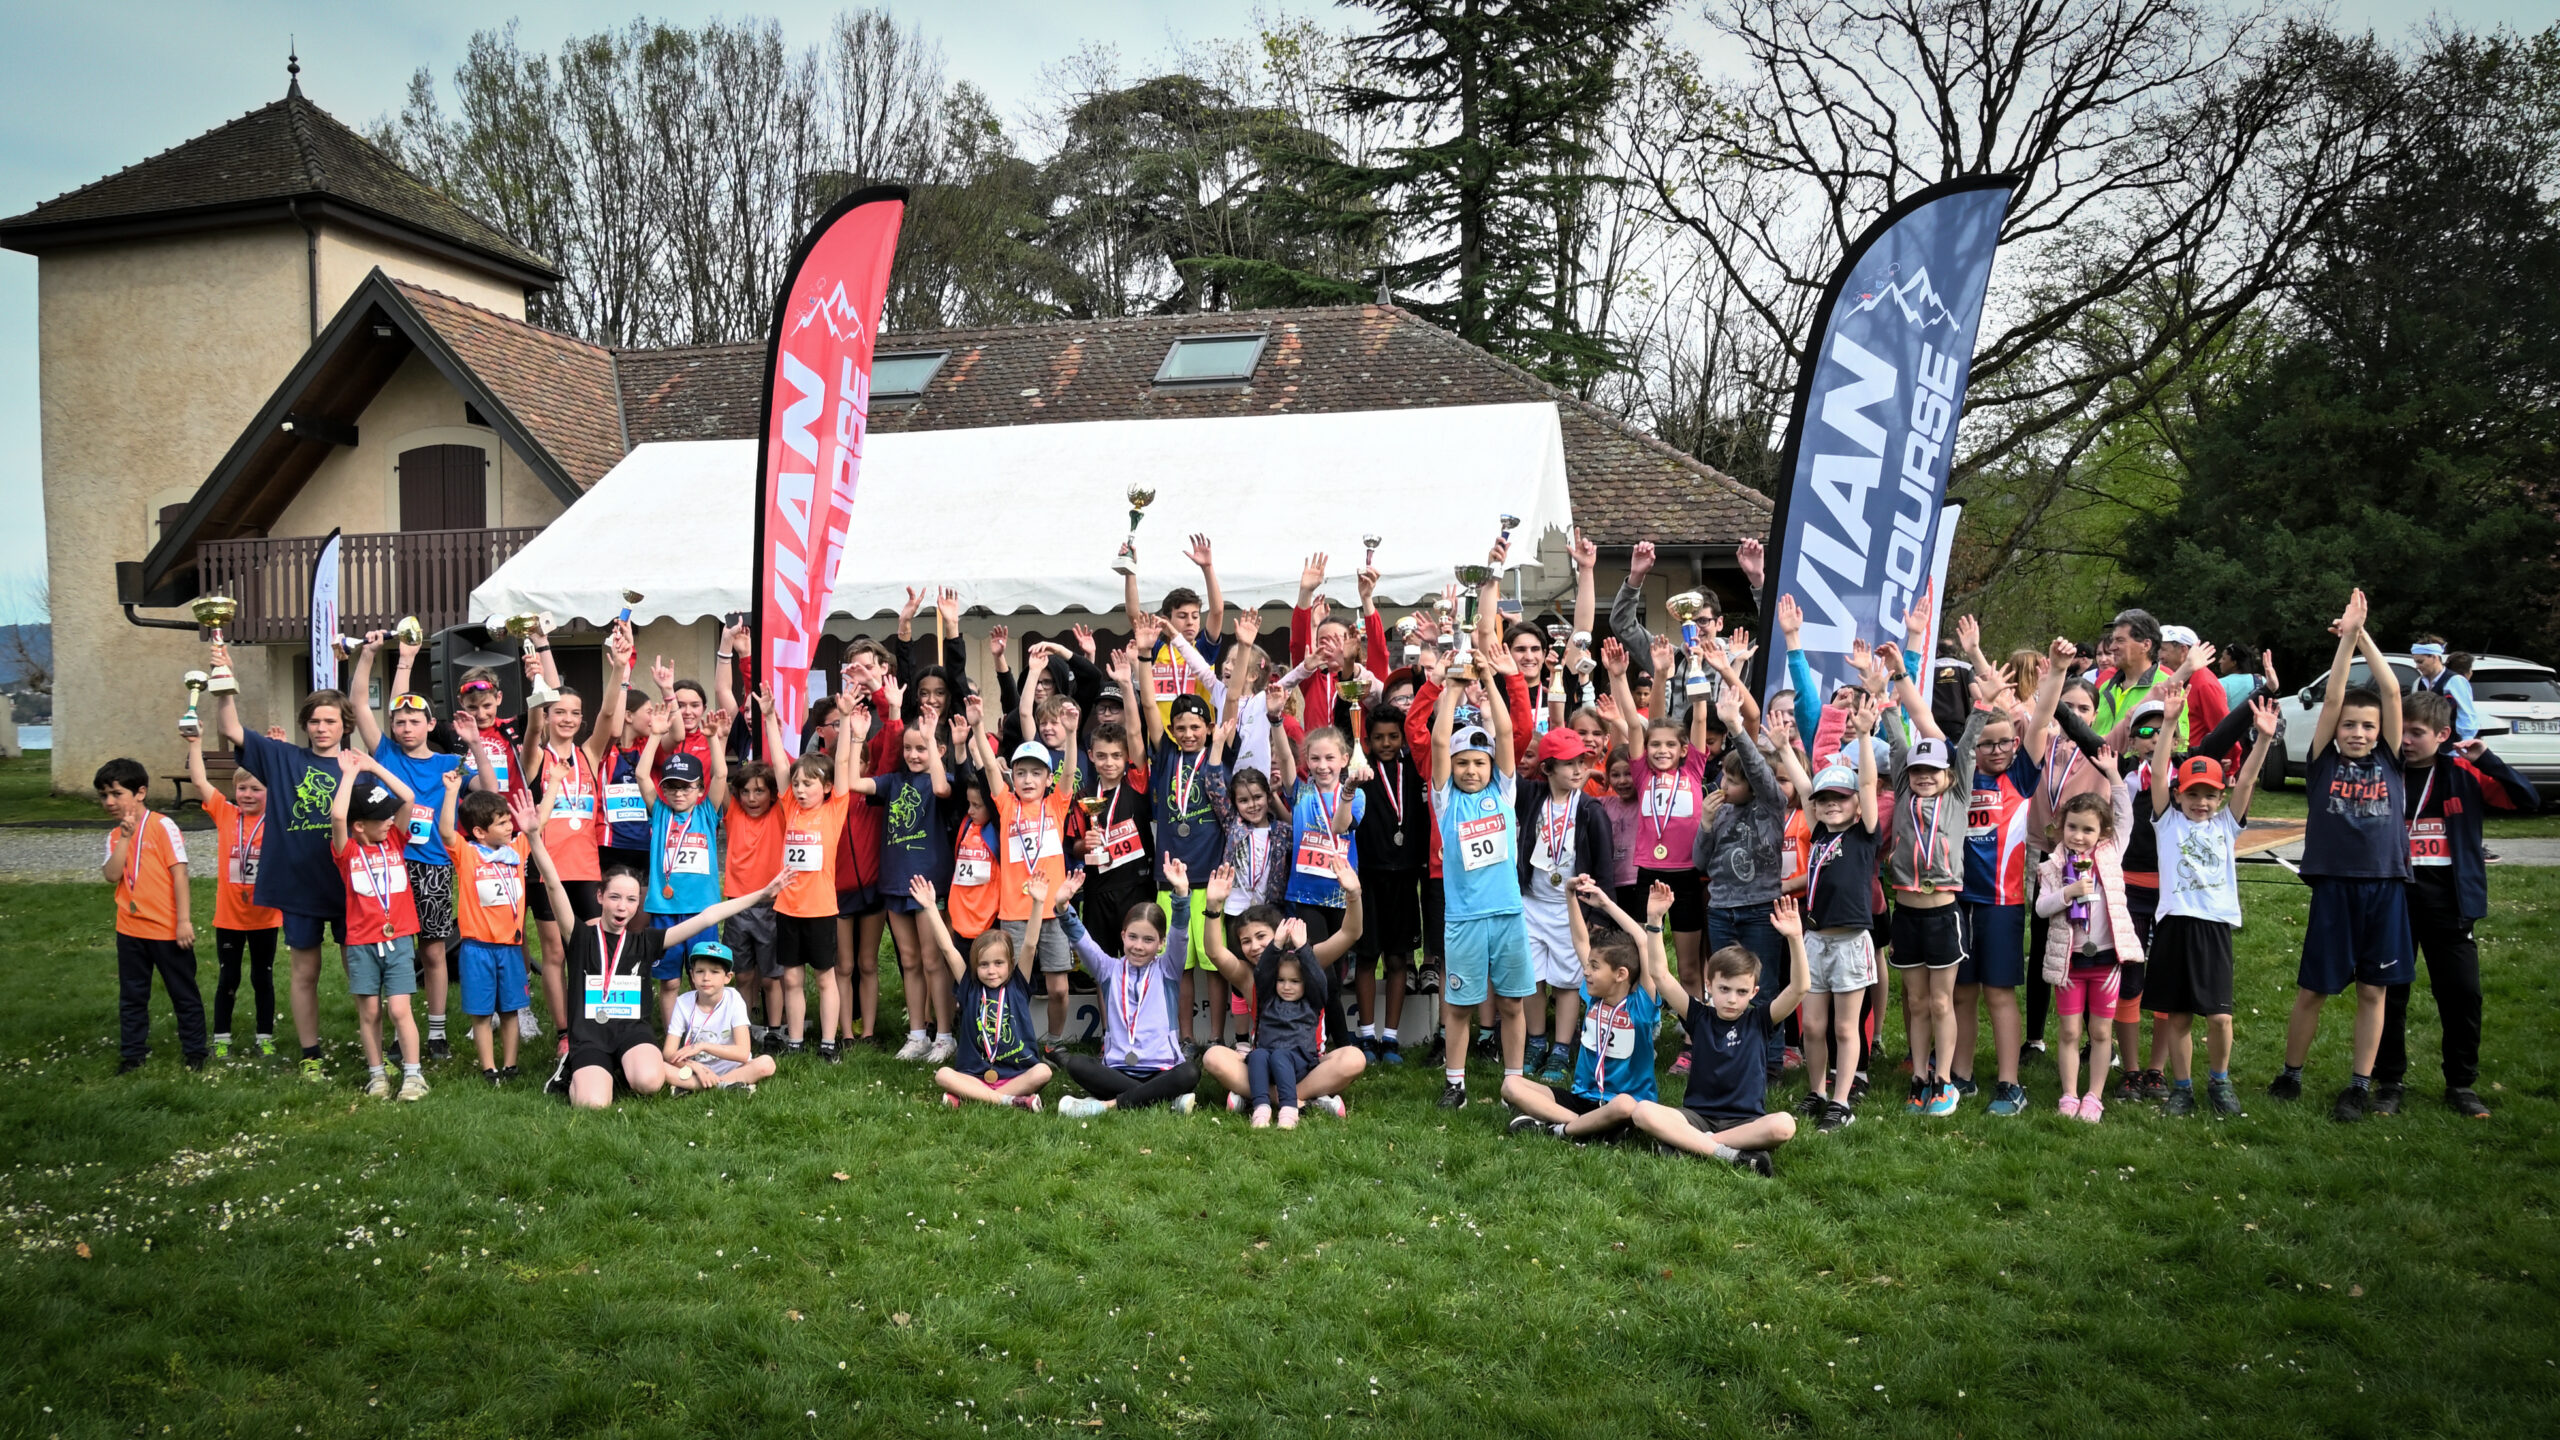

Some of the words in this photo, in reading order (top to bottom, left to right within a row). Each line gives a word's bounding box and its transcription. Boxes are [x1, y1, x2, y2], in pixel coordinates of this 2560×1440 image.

[818, 355, 869, 634] OURSE
[1878, 341, 1959, 640] COURSE
[773, 350, 826, 760] EVIAN
[1157, 680, 1183, 693] 15
[553, 798, 586, 810] 28
[620, 797, 640, 807] 507
[1113, 840, 1132, 856] 49
[1471, 839, 1494, 858] 50
[2415, 839, 2440, 855] 30
[678, 850, 697, 864] 27
[789, 849, 806, 862] 22
[959, 863, 974, 877] 24
[1077, 1004, 1102, 1041] 2
